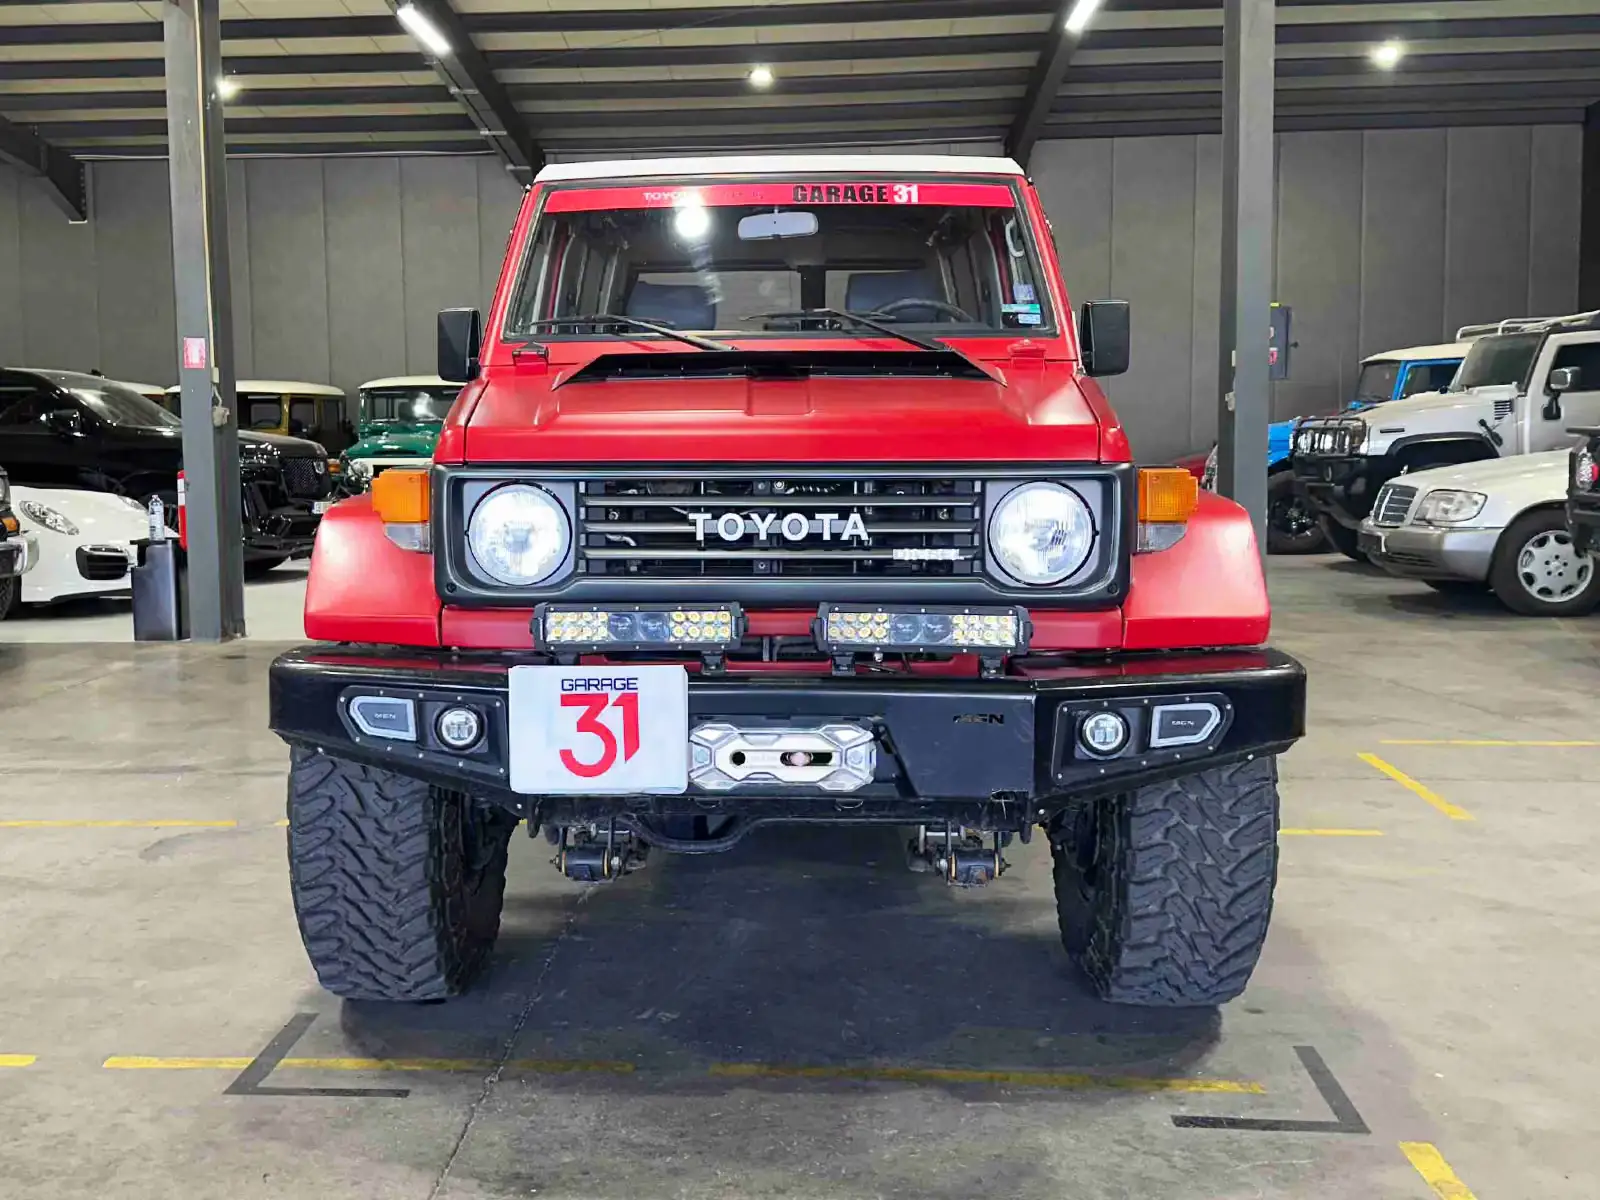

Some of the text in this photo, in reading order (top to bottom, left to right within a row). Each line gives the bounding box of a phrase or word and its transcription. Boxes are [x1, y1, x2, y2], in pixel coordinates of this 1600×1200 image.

[793, 184, 918, 203] GARAGE 31
[689, 512, 869, 541] TOYOTA
[561, 677, 638, 691] GARAGE
[559, 692, 640, 777] 31
